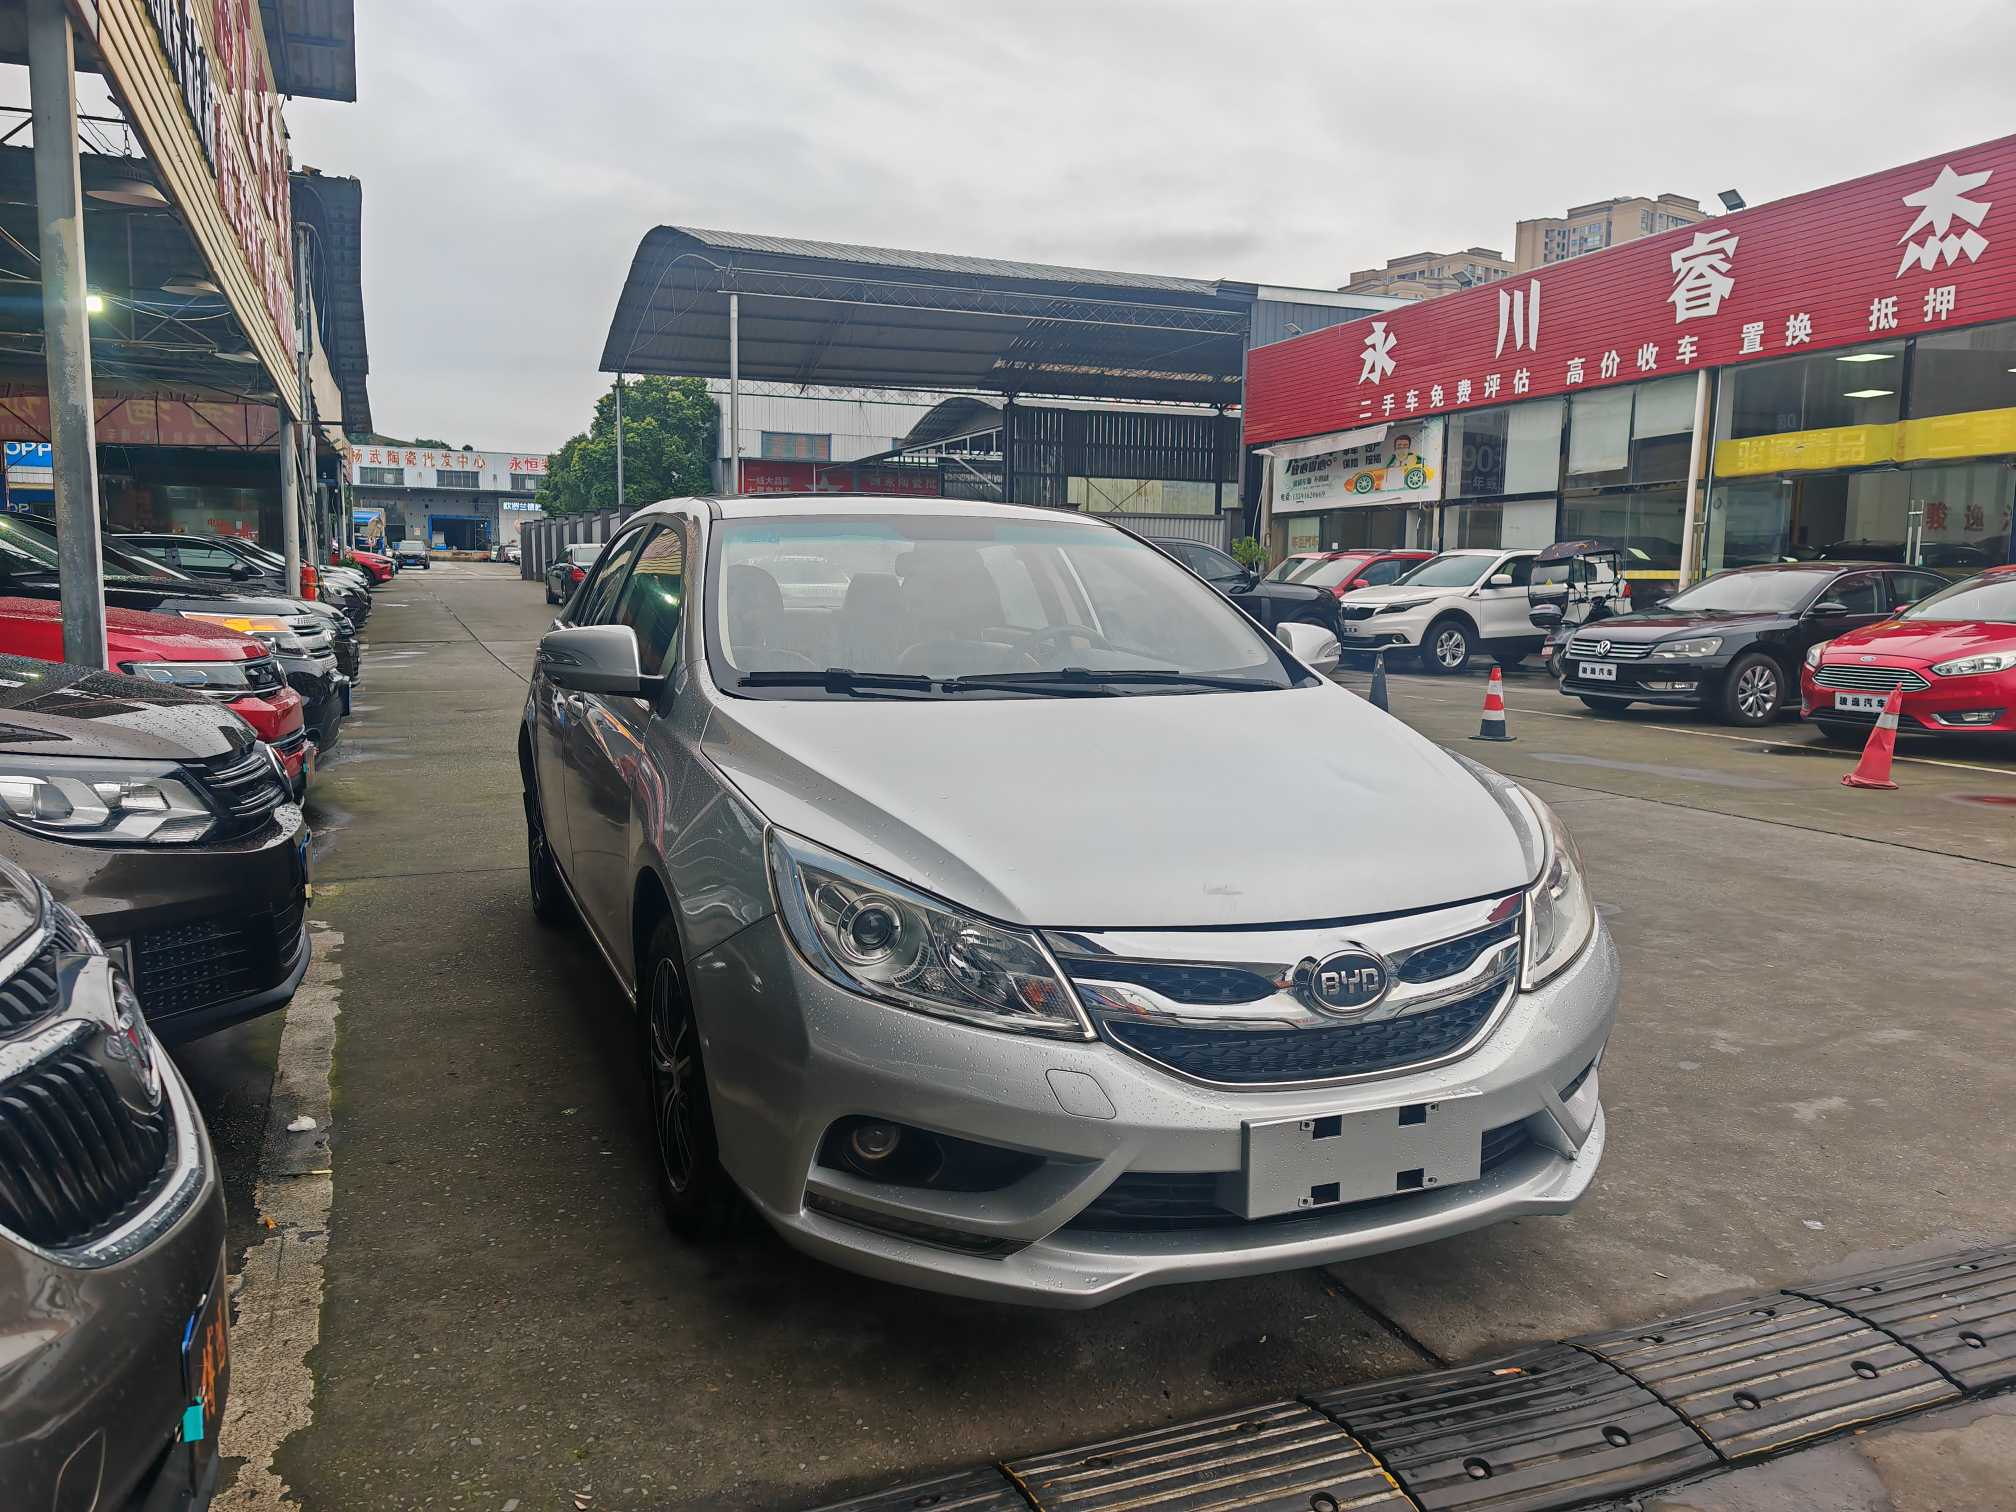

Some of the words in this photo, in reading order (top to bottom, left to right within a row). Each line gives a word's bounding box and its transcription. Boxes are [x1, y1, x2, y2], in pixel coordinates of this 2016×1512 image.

[1358, 163, 1994, 386] 永川睿杰
[1359, 367, 1531, 419] 二手车免费评估
[1566, 335, 1699, 386] 高价收车
[1738, 312, 1813, 355] 置换
[1868, 284, 1957, 332] 抵押
[1321, 968, 1379, 996] BYD
